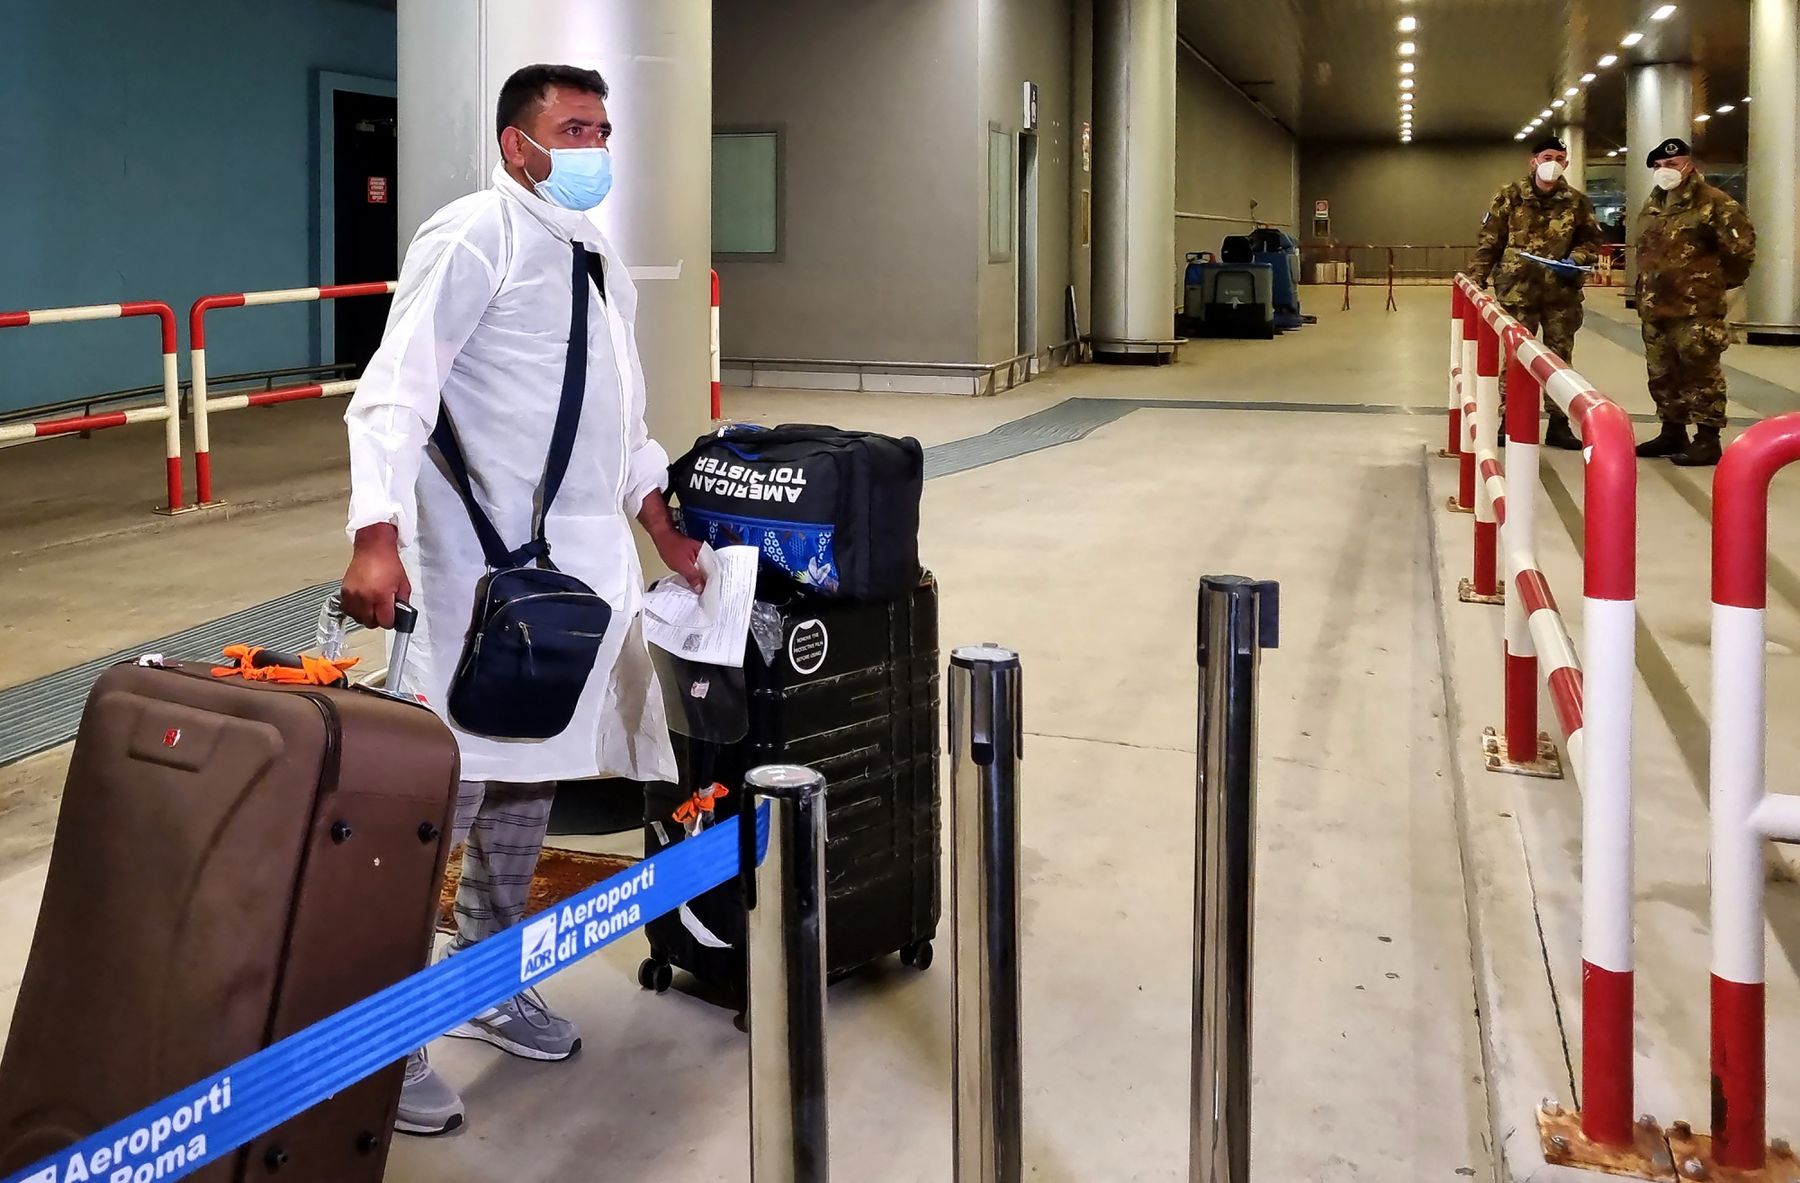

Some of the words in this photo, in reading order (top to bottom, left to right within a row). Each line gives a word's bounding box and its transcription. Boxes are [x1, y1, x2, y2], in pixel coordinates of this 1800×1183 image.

[689, 473, 803, 503] AMERICAN
[558, 863, 655, 934] Aeroporti
[557, 930, 578, 962] di
[584, 904, 641, 949] Roma
[524, 949, 552, 978] ADR
[64, 1076, 231, 1183] Aeroporti
